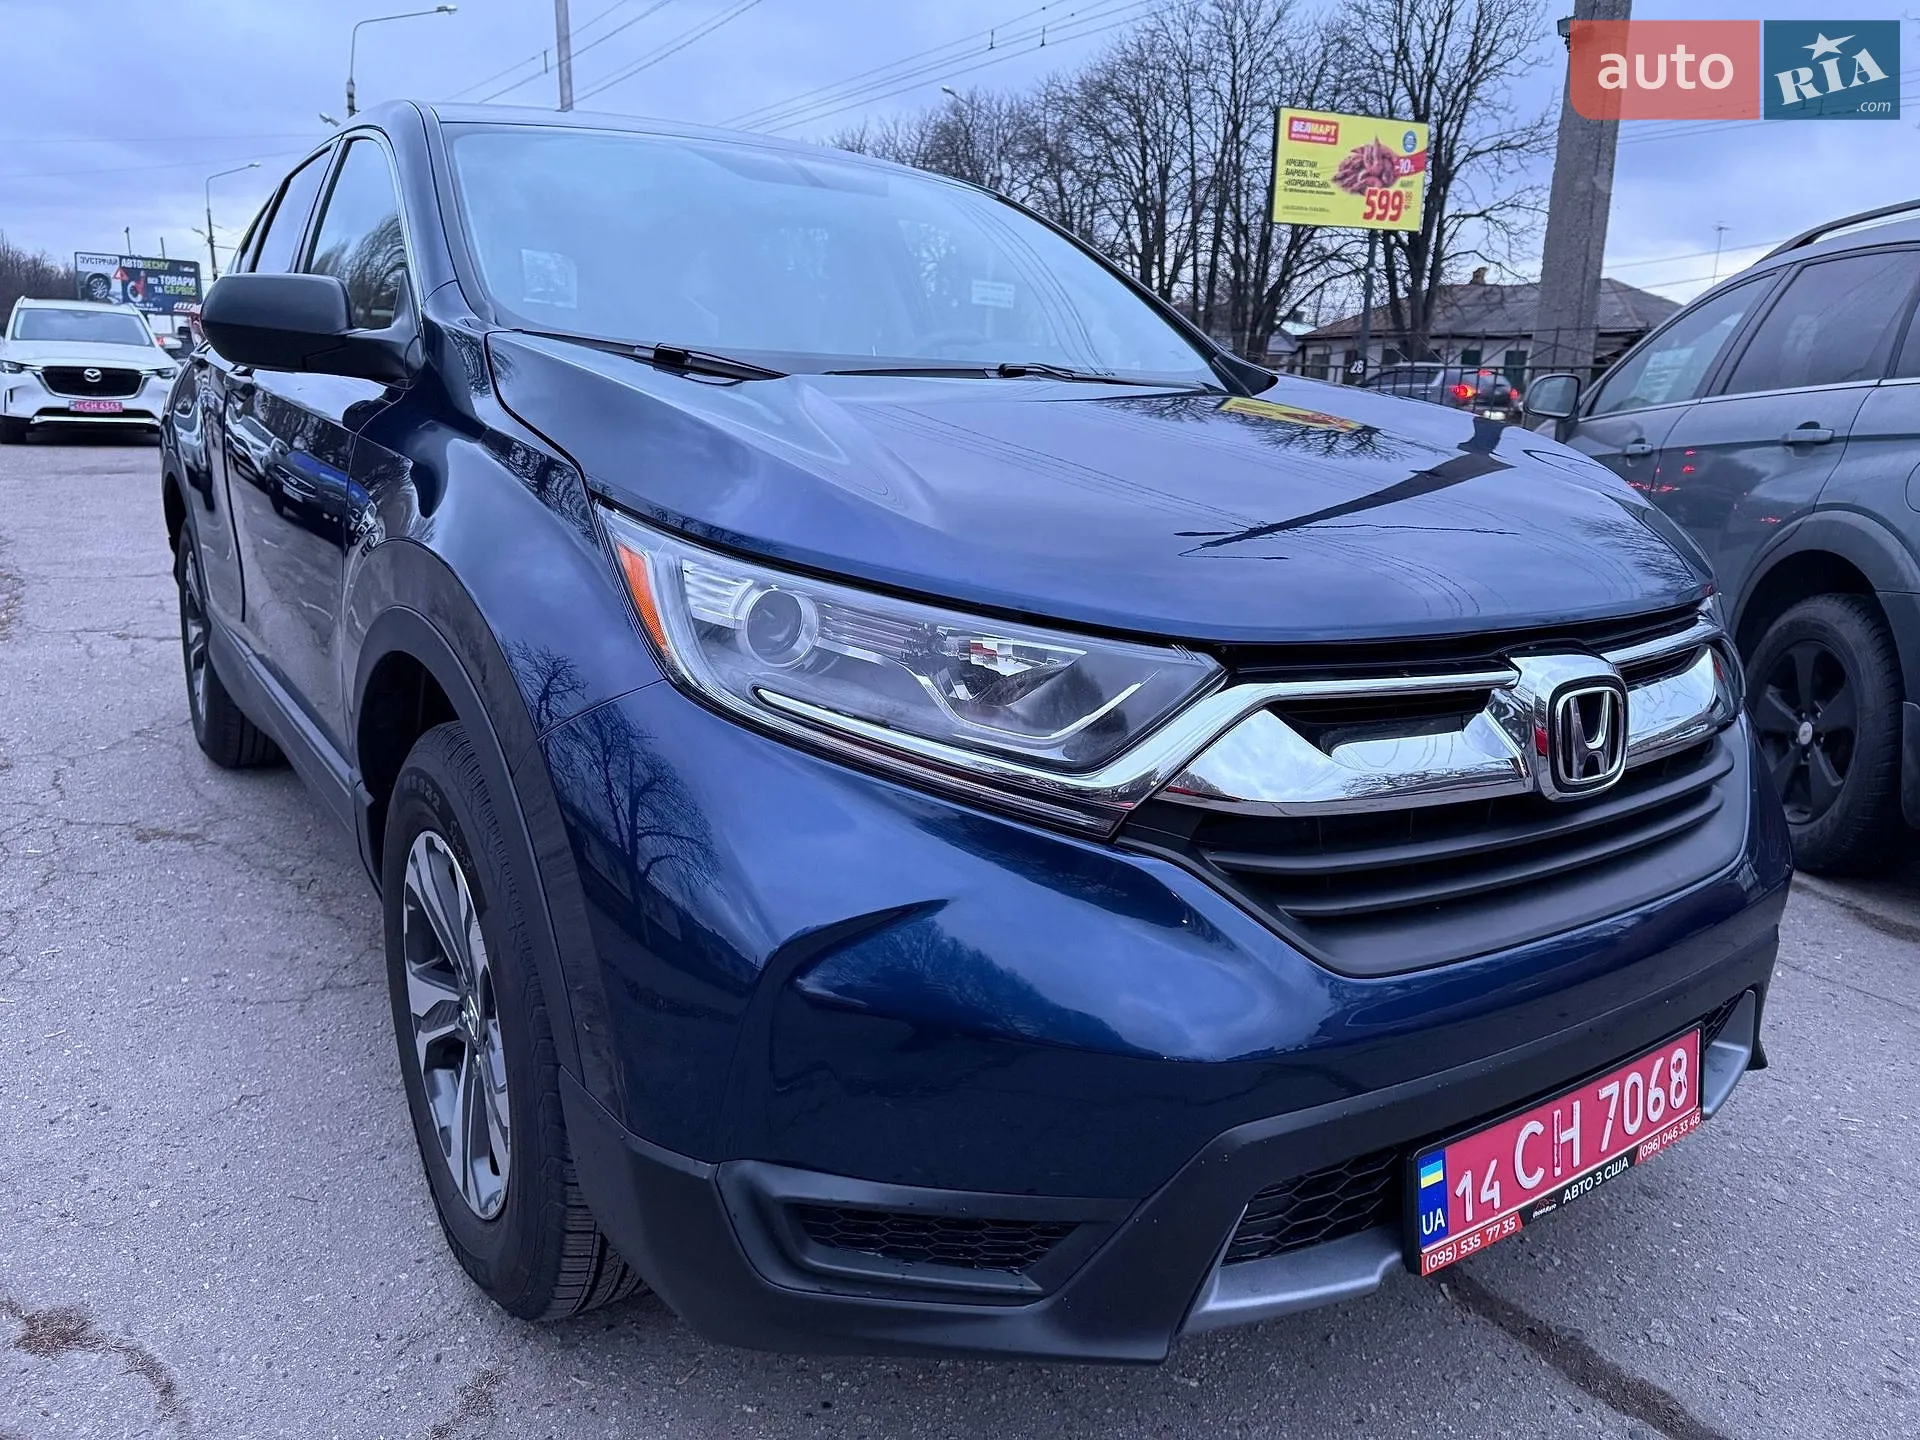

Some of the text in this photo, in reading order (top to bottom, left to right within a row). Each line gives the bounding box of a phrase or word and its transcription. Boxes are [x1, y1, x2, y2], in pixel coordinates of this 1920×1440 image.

[1363, 187, 1404, 221] 599
[1350, 359, 1364, 374] 28
[1455, 1047, 1688, 1222] 14 CH 7068
[1639, 1134, 1661, 1160] (096)
[1662, 1126, 1679, 1145] 046
[1563, 1176, 1594, 1204] АВТО
[1604, 1156, 1629, 1180] США
[1422, 1207, 1446, 1236] UA
[1426, 1216, 1516, 1273] (095) 535 77 35
